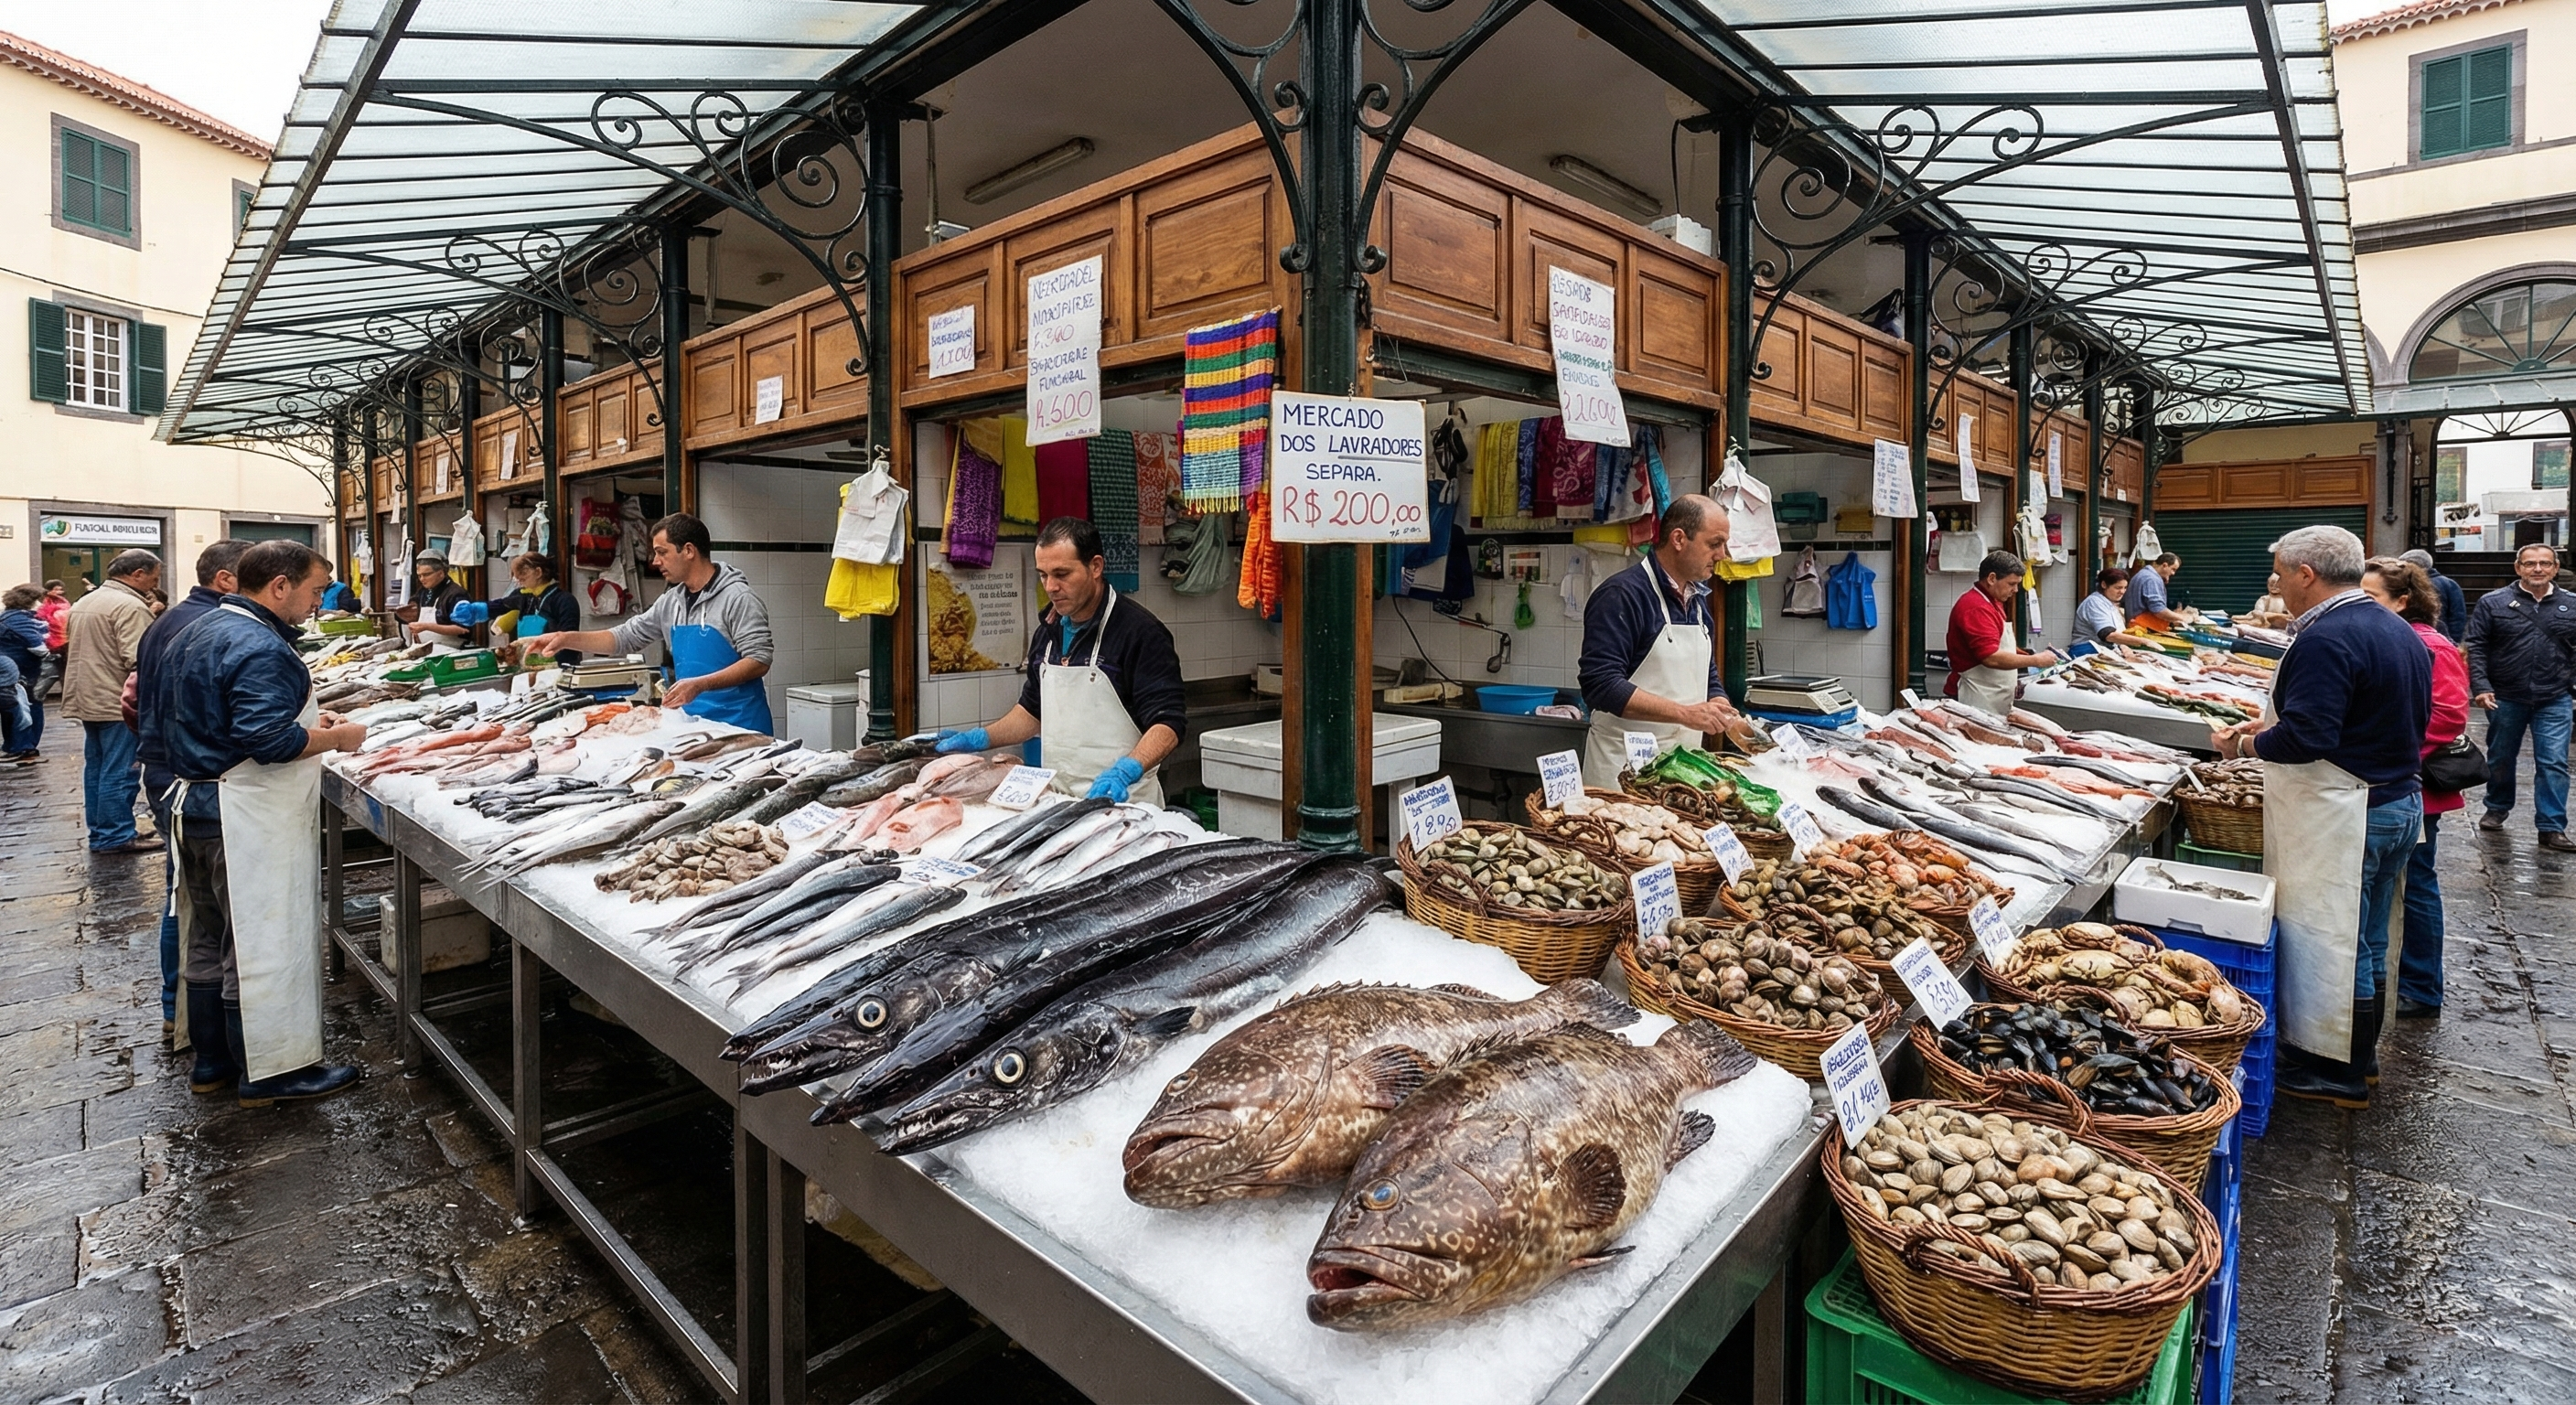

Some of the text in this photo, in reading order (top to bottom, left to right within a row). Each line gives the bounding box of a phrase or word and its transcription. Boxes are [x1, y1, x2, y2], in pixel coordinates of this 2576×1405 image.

[1283, 403, 1384, 430] MERCADO
[1280, 434, 1422, 457] DOS LAVRADORES
[1306, 463, 1381, 482] SEPARA.
